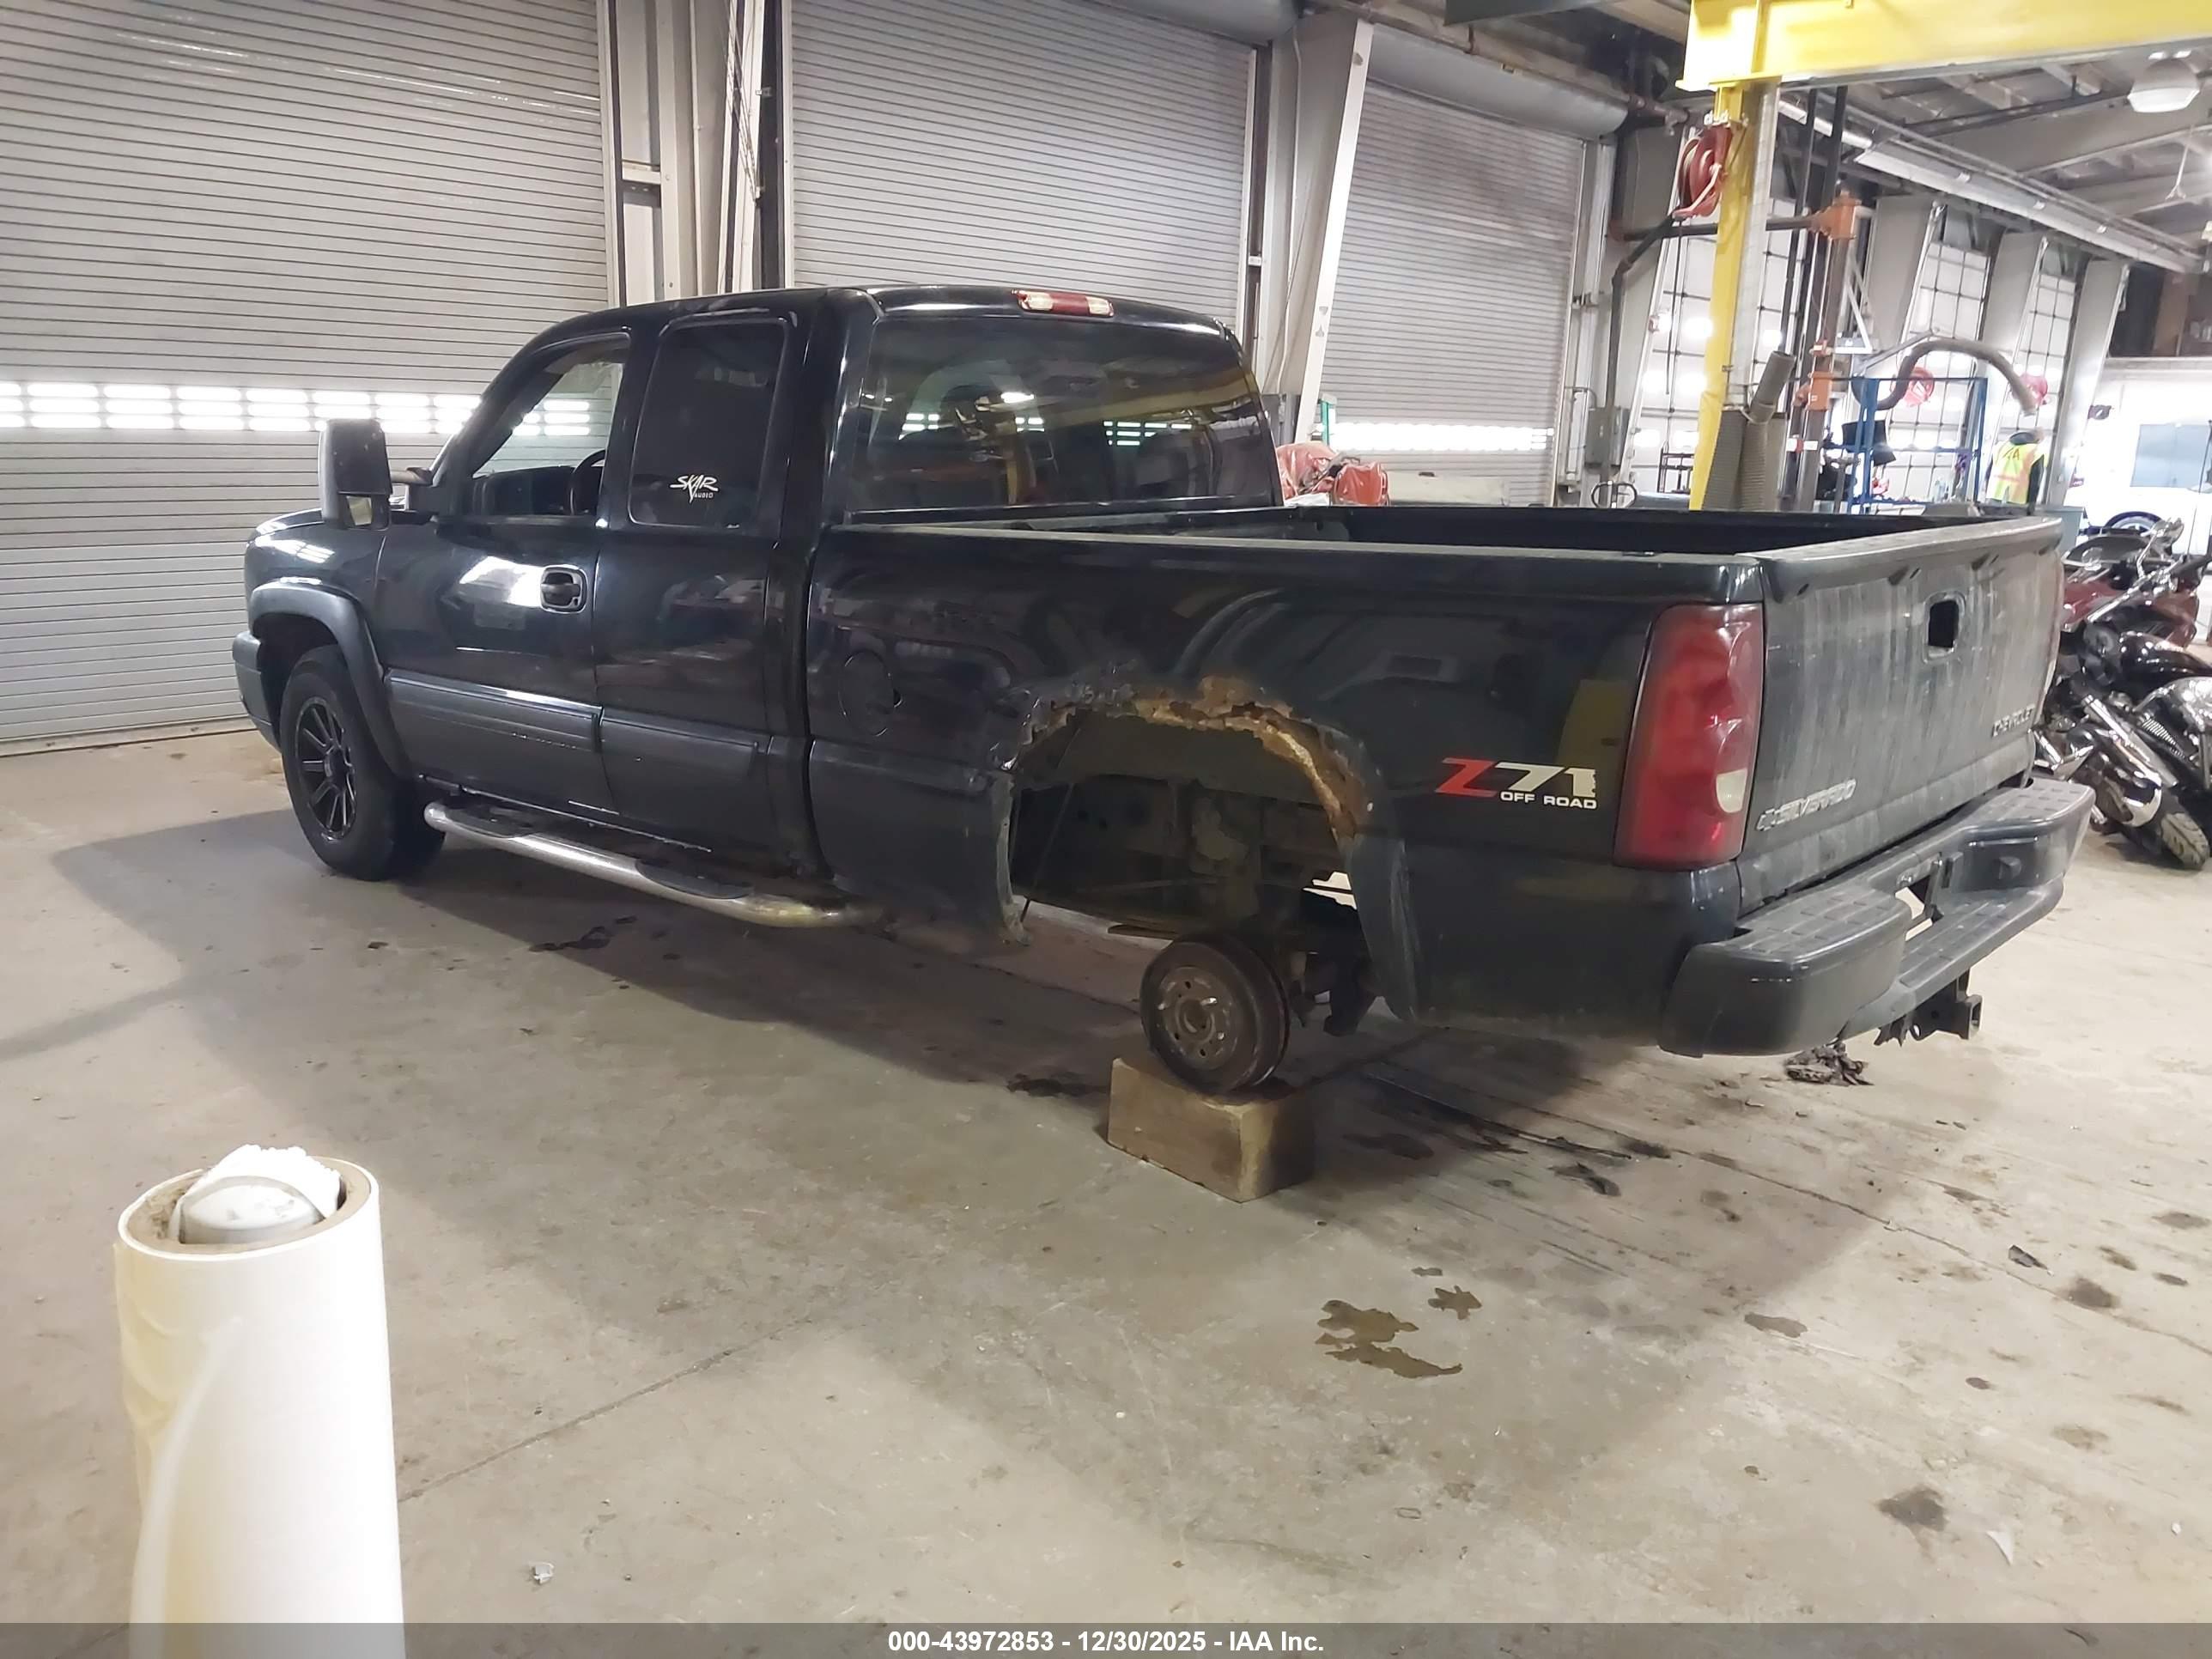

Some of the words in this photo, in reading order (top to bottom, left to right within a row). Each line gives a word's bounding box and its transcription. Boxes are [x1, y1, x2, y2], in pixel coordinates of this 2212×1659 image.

[670, 474, 719, 503] SKAR
[1434, 757, 1597, 798] Z71
[1500, 791, 1535, 804] OFF
[1543, 795, 1597, 810] ROAD
[1774, 778, 1856, 825] SILVERADO
